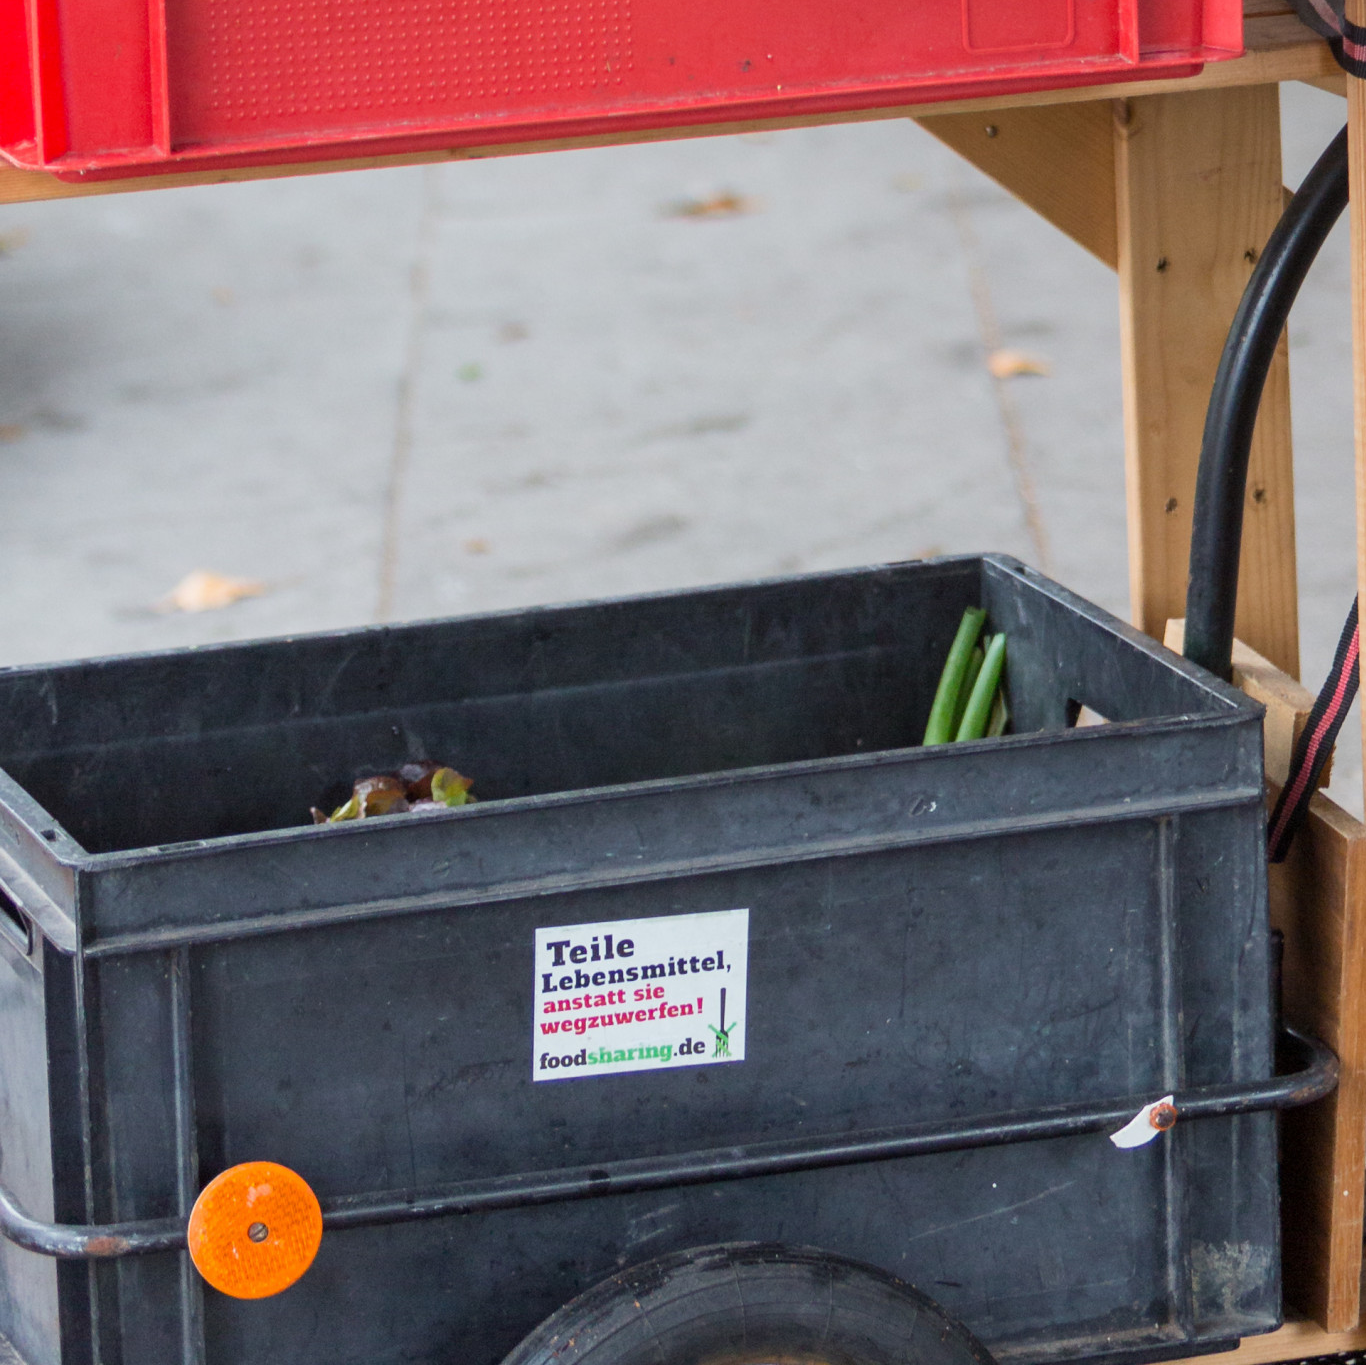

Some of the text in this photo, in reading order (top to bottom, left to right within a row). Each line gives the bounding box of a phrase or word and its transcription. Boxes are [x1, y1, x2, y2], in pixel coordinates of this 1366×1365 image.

[546, 934, 635, 967] Teile
[541, 950, 731, 993] Lebensmittel,
[543, 983, 665, 1014] anstatt sie
[540, 997, 704, 1035] wegzuwerfen!
[539, 1038, 706, 1070] foodsharing.de
